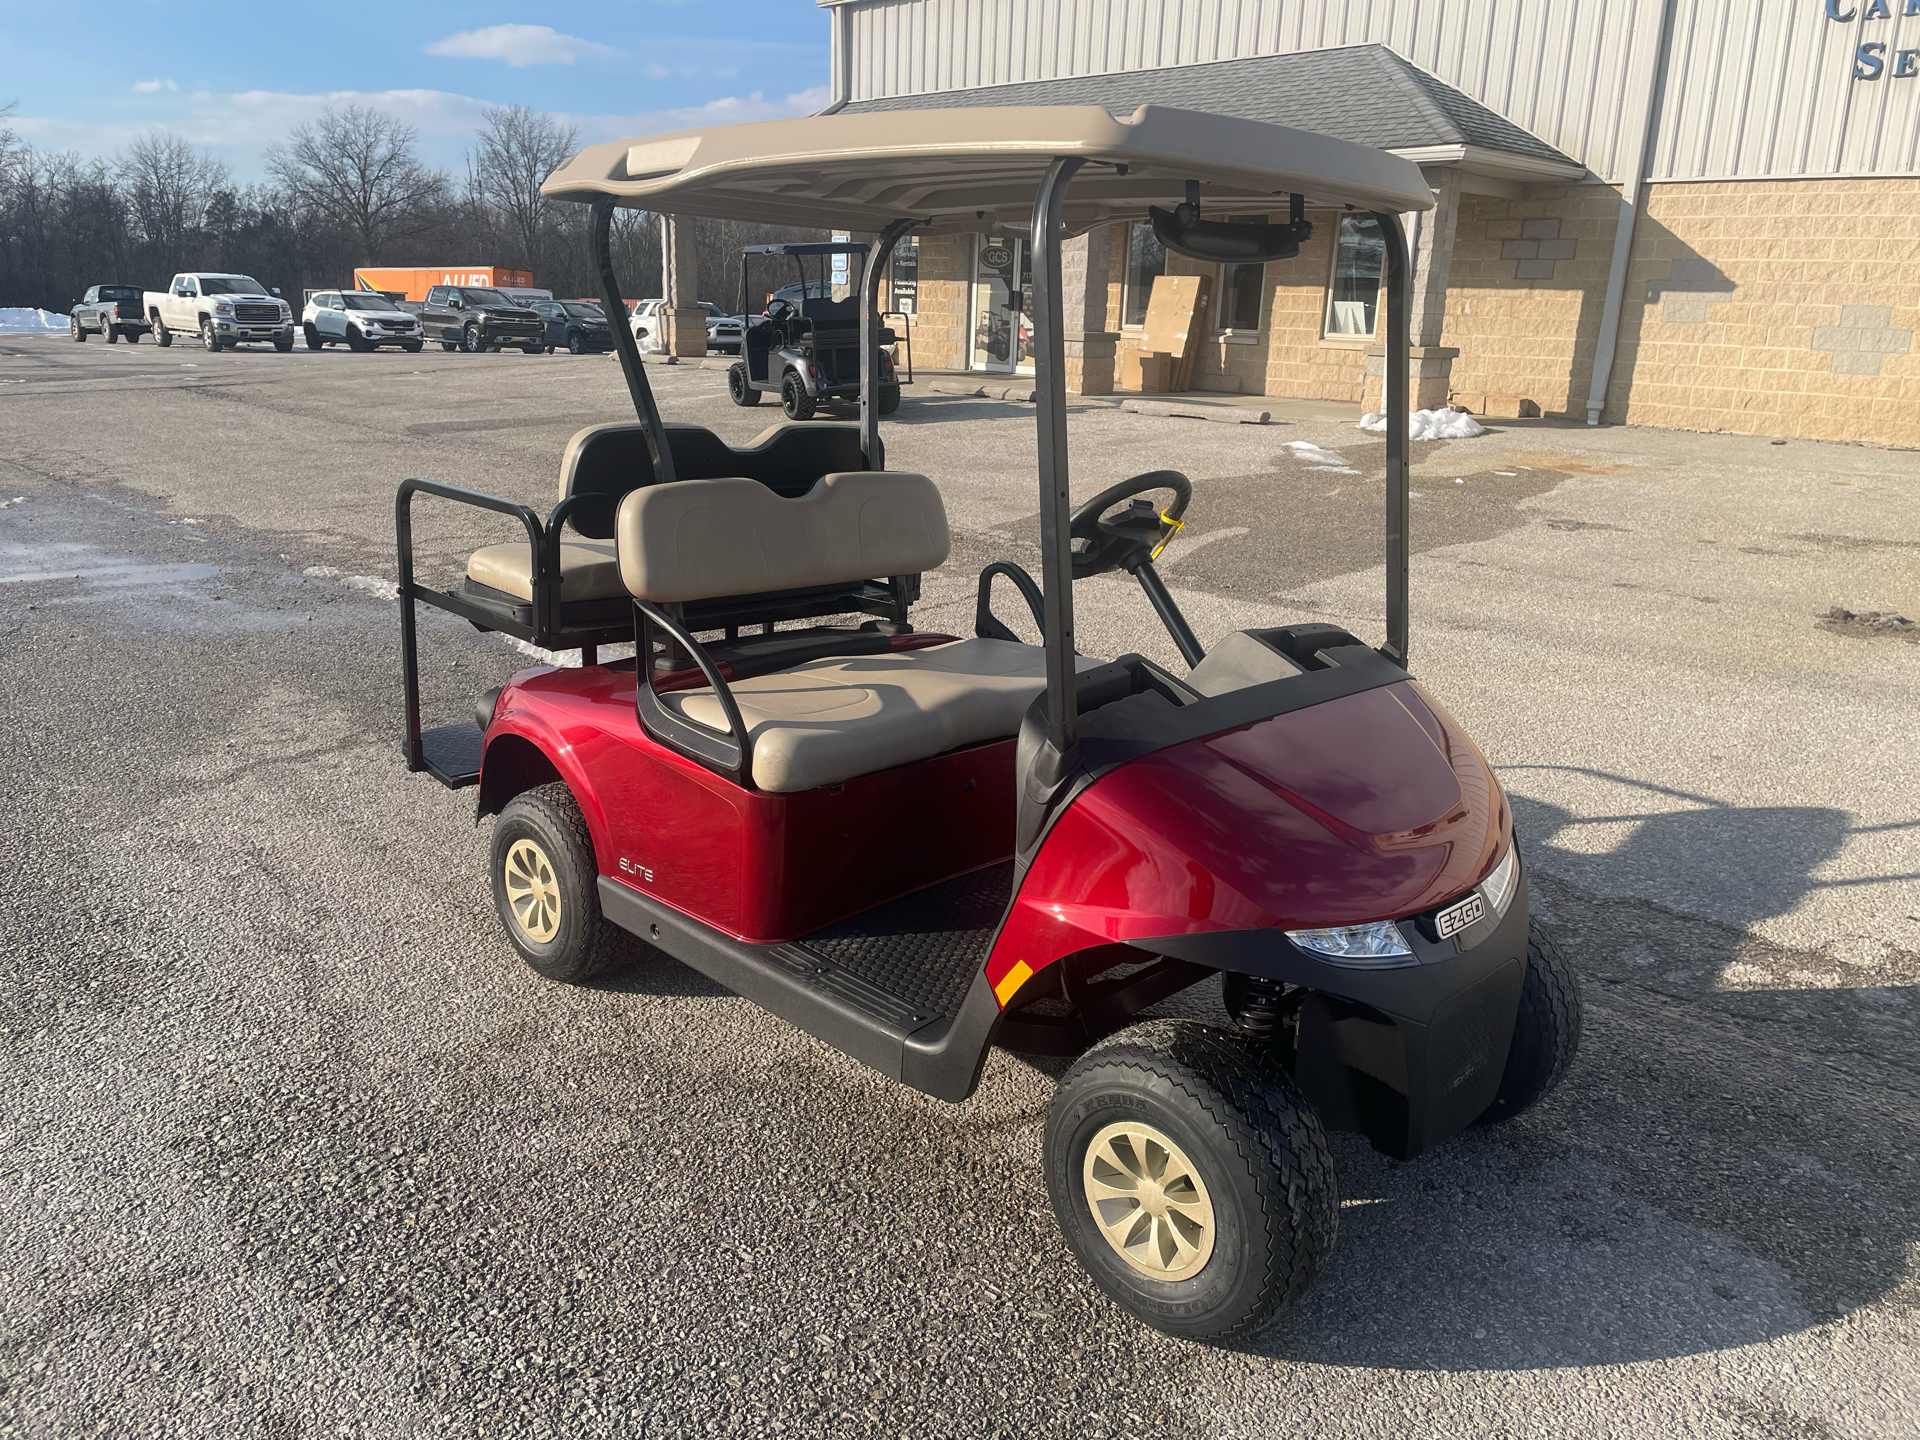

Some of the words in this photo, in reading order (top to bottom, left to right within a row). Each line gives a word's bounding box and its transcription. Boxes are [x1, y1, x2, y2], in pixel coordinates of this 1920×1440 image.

[988, 251, 1008, 263] GCS
[900, 259, 917, 267] Rentals
[894, 278, 917, 287] Financing
[894, 287, 916, 295] Available
[619, 857, 653, 882] ELITE
[1079, 1094, 1149, 1114] KENDA
